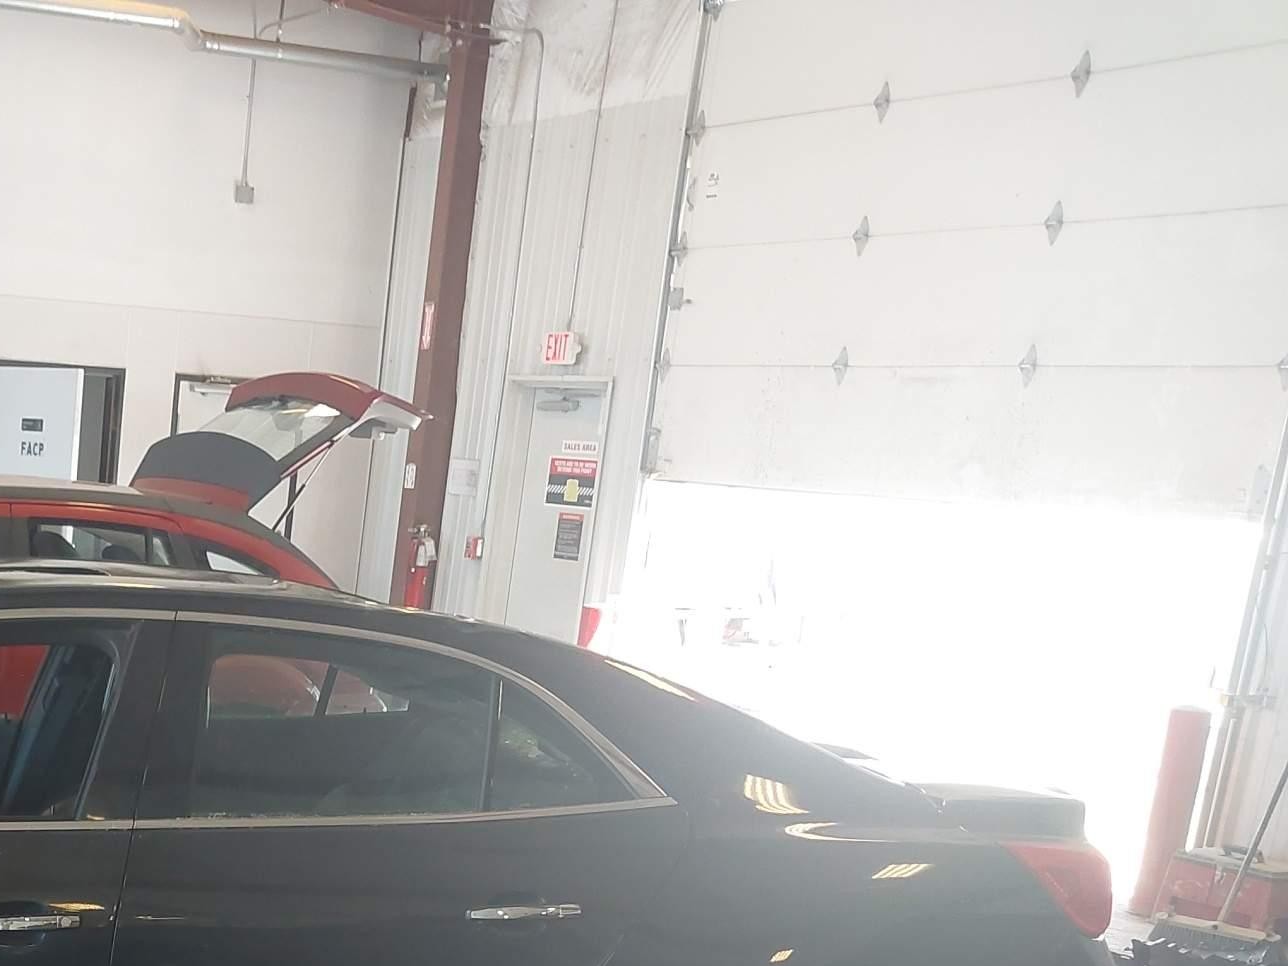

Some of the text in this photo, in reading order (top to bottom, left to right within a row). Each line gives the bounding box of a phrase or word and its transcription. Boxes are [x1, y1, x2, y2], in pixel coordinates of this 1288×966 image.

[545, 334, 569, 361] EXIT
[20, 441, 44, 456] FACP
[564, 442, 596, 453] SALES AREA
